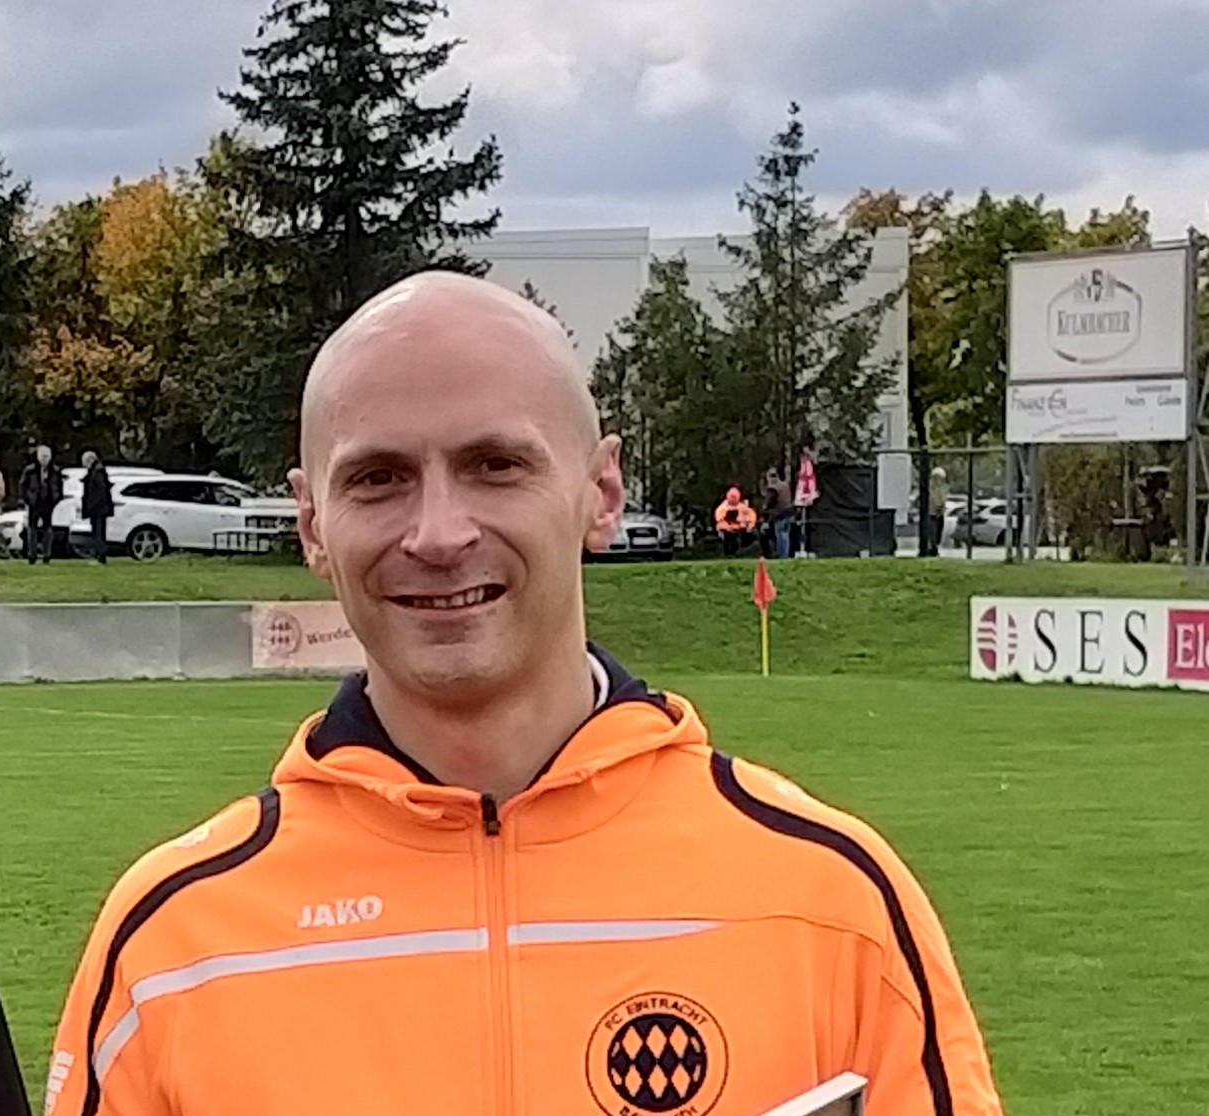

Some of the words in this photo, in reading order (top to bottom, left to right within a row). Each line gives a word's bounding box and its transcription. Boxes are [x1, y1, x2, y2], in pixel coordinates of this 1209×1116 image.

[1033, 608, 1149, 677] SES
[1175, 622, 1209, 668] El
[296, 895, 383, 928] JAKO
[605, 1014, 623, 1030] FC
[626, 998, 708, 1027] EINTRACHT
